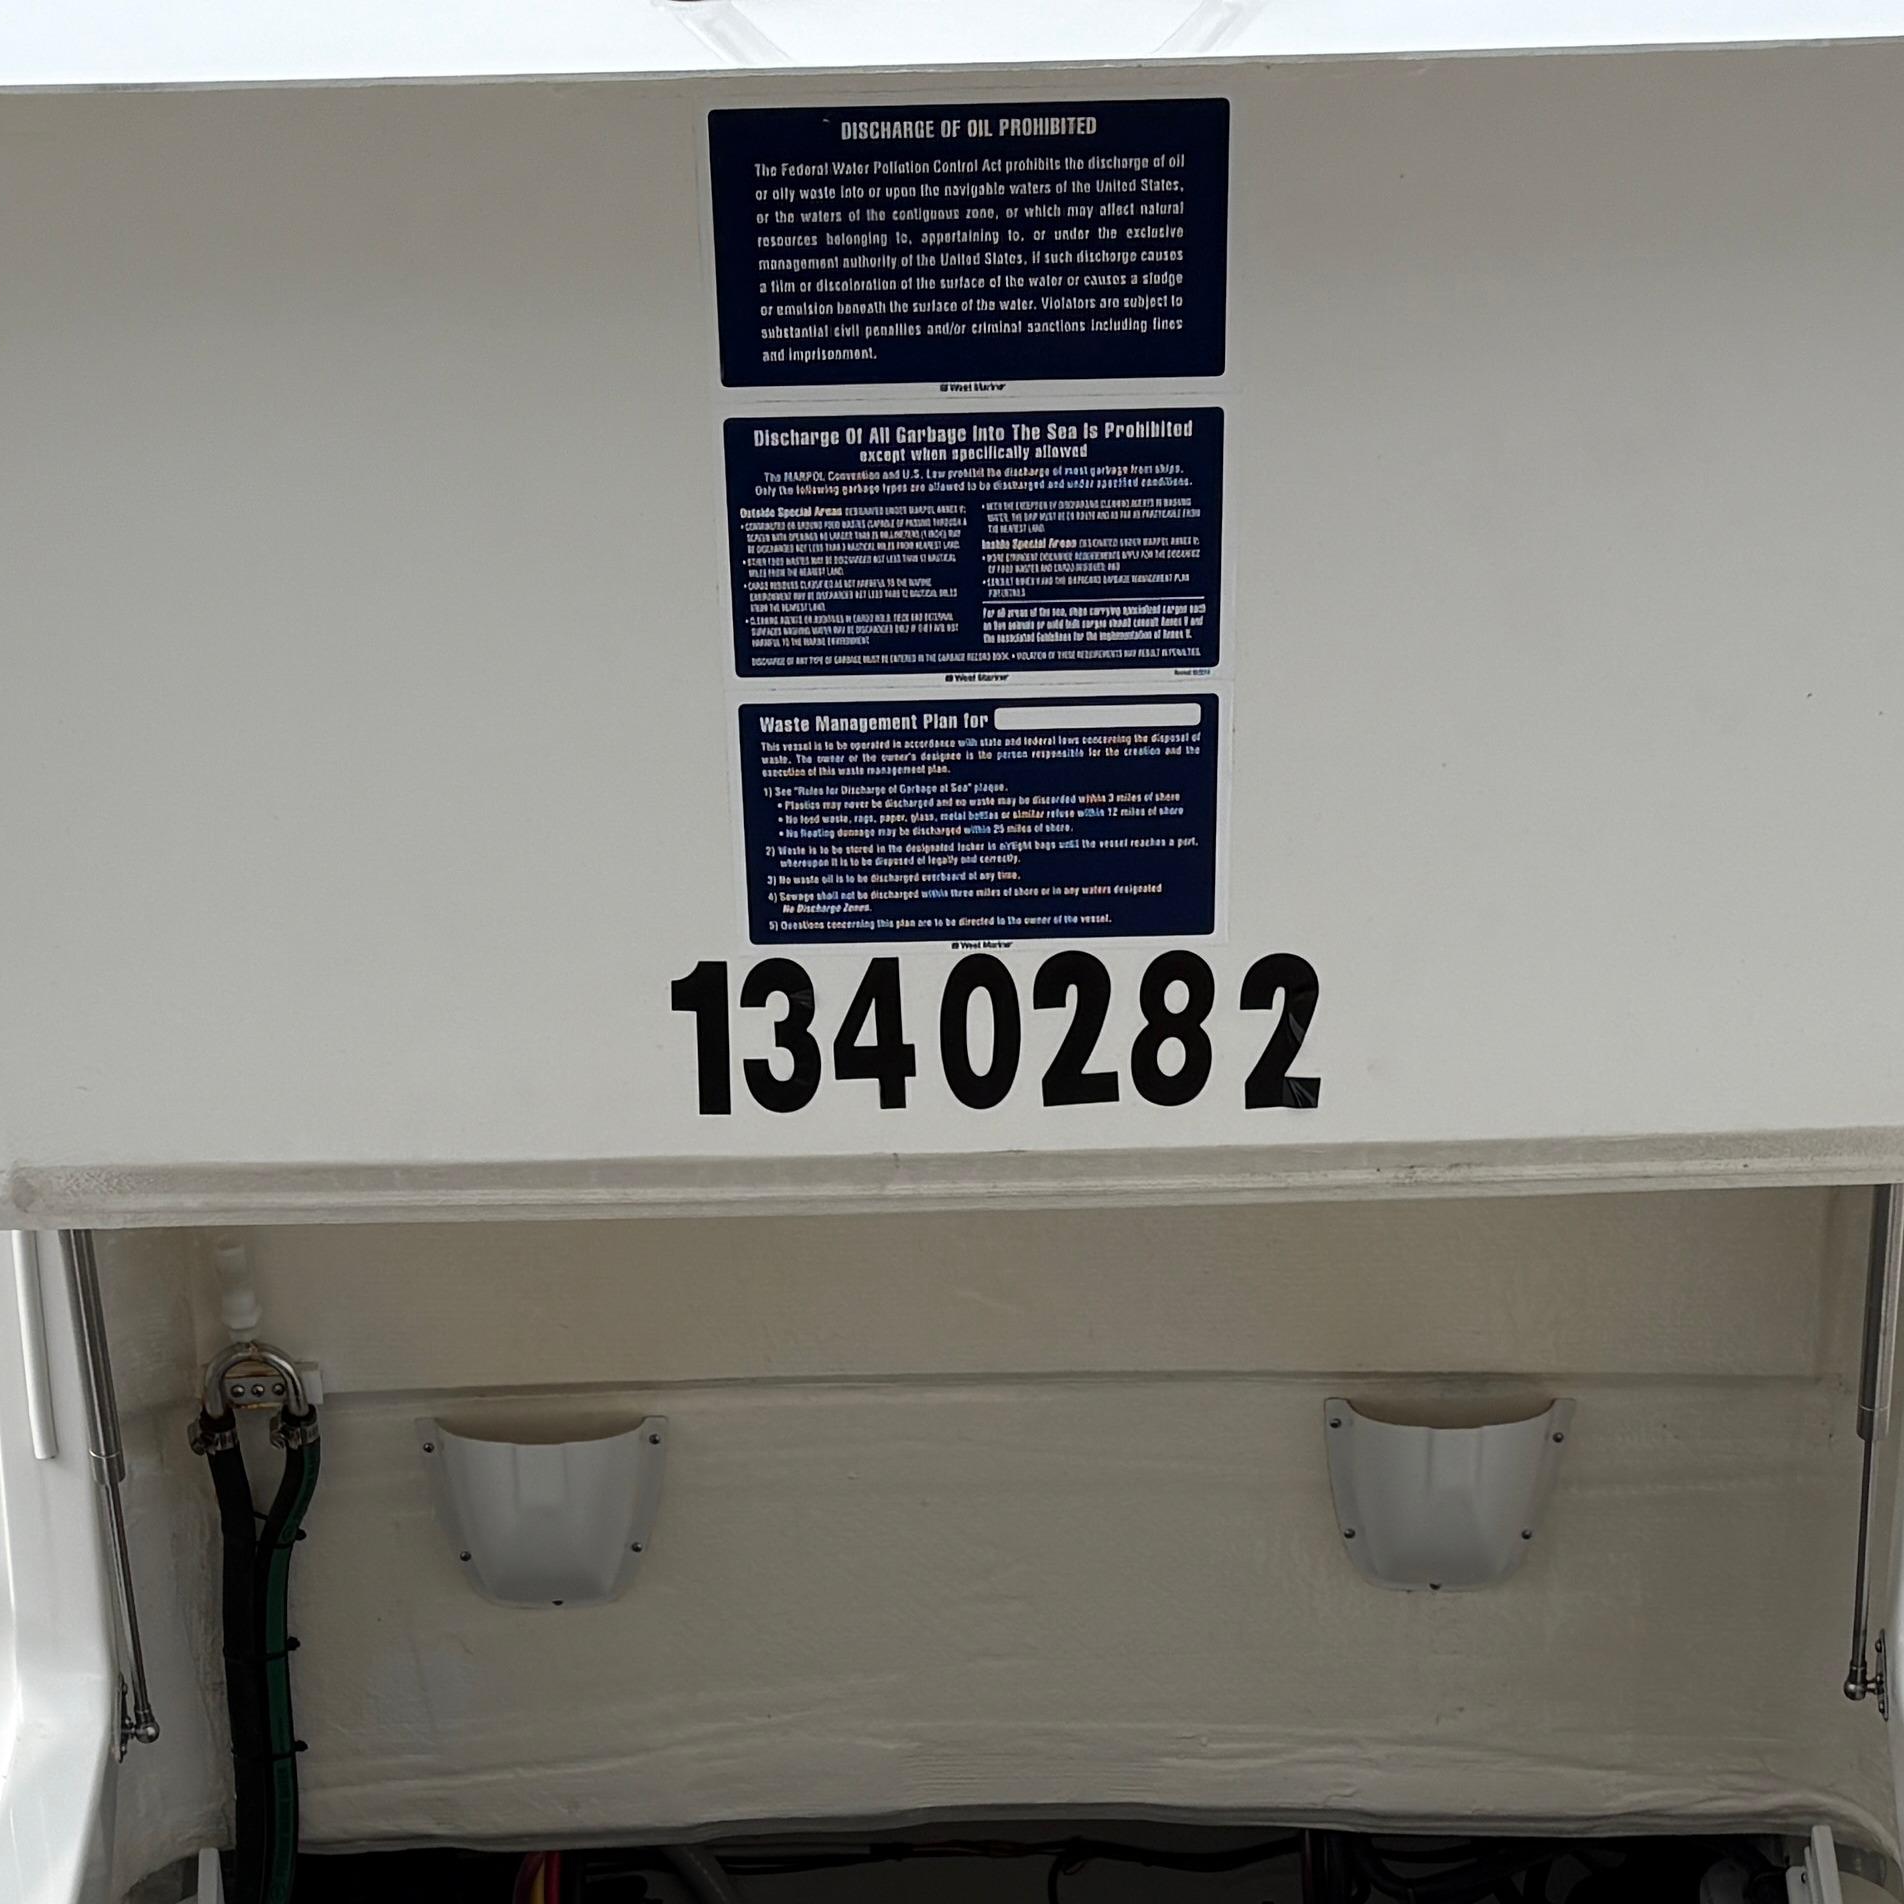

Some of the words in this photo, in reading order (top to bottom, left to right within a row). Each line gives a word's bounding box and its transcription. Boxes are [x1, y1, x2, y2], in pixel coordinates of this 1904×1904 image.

[840, 119, 935, 140] DISCHARGE
[939, 118, 961, 138] OF
[966, 118, 993, 138] OIL
[998, 115, 1097, 137] PROHIBITED
[753, 162, 777, 177] The
[780, 161, 829, 177] Federal
[830, 160, 870, 176] Water
[872, 159, 930, 175] Pollution
[932, 158, 978, 174] Control
[980, 157, 1002, 172] Act
[1004, 156, 1061, 174] prohibits
[1063, 156, 1085, 171] the
[1087, 154, 1149, 171] discharge
[1152, 153, 1166, 168] of
[1167, 152, 1185, 168] oil
[754, 188, 768, 201] or
[771, 186, 796, 203] oily
[798, 185, 836, 200] waste
[839, 184, 865, 199] into
[867, 186, 881, 198] or
[884, 185, 916, 200] upon
[919, 182, 940, 197] the
[943, 180, 1005, 199] navigable
[1008, 180, 1052, 195] waters
[1054, 179, 1068, 194] of
[1070, 179, 1091, 193] the
[1094, 177, 1137, 193] United
[1139, 177, 1184, 193] States,
[755, 212, 770, 224] or
[773, 209, 795, 224] the
[799, 209, 842, 223] waters
[847, 207, 861, 222] of
[865, 207, 886, 222] the
[891, 206, 960, 223] contiguous
[964, 207, 999, 220] zone,
[1004, 206, 1019, 219] or
[1023, 202, 1061, 218] which
[1066, 204, 1094, 219] may
[1098, 201, 1135, 217] affect
[1139, 199, 1184, 215] natural
[756, 234, 818, 248] resources
[825, 230, 888, 248] belonging
[894, 230, 912, 245] to,
[920, 227, 1000, 246] appertaining
[1006, 228, 1025, 242] to,
[1032, 228, 1046, 241] or
[1053, 226, 1090, 241] under
[1096, 225, 1118, 240] the
[1125, 223, 1184, 239] exclusive
[757, 255, 839, 273] management
[841, 253, 897, 270] authority
[900, 252, 913, 267] of
[915, 252, 936, 267] the
[939, 251, 981, 267] United
[983, 250, 1028, 265] States,
[1031, 249, 1041, 264] if
[1043, 249, 1073, 264] such
[1075, 248, 1137, 265] discharge
[1139, 248, 1184, 262] causes
[758, 281, 767, 294] a
[769, 278, 796, 293] film
[798, 280, 812, 293] or
[815, 277, 897, 292] discoloration
[899, 275, 913, 290] of
[915, 275, 936, 290] the
[939, 274, 985, 289] surface
[988, 273, 1002, 288] of
[1004, 273, 1025, 288] the
[1027, 273, 1063, 287] water
[1066, 274, 1080, 287] or
[1082, 273, 1127, 286] causes
[1129, 273, 1138, 285] a
[1141, 270, 1183, 287] sludge
[759, 304, 773, 317] or
[775, 300, 834, 316] emulsion
[835, 299, 886, 315] beneath
[888, 299, 909, 313] the
[911, 298, 958, 313] surface
[960, 297, 974, 312] of
[975, 297, 996, 311] the
[997, 296, 1037, 311] water.
[1040, 295, 1096, 310] Violators
[1098, 296, 1120, 309] are
[1122, 293, 1168, 310] subject
[1170, 293, 1183, 307] to
[760, 323, 829, 339] substantial
[833, 322, 860, 338] civil
[864, 321, 922, 339] penalties
[925, 320, 966, 336] and/or
[970, 319, 1022, 335] criminal
[1026, 318, 1086, 333] sanctions
[1090, 316, 1148, 333] including
[1151, 315, 1183, 331] fines
[761, 347, 785, 363] and
[787, 345, 877, 363] imprisonment.
[752, 427, 840, 448] Discharge
[844, 426, 863, 445] Of
[867, 425, 890, 444] All
[895, 424, 967, 445] Garbage
[971, 423, 1005, 442] Into
[1010, 422, 1041, 441] The
[1045, 422, 1078, 441] Sea
[1082, 421, 1098, 440] Is
[1103, 418, 1193, 439] Prohibited
[858, 446, 906, 464] except
[909, 445, 947, 461] when
[950, 443, 1030, 462] specifically
[1034, 442, 1088, 459] allowed
[758, 715, 810, 733] Waste
[814, 713, 918, 734] Management
[922, 712, 958, 730] Plan
[962, 711, 989, 729] for
[670, 950, 1322, 1116] 1340282
